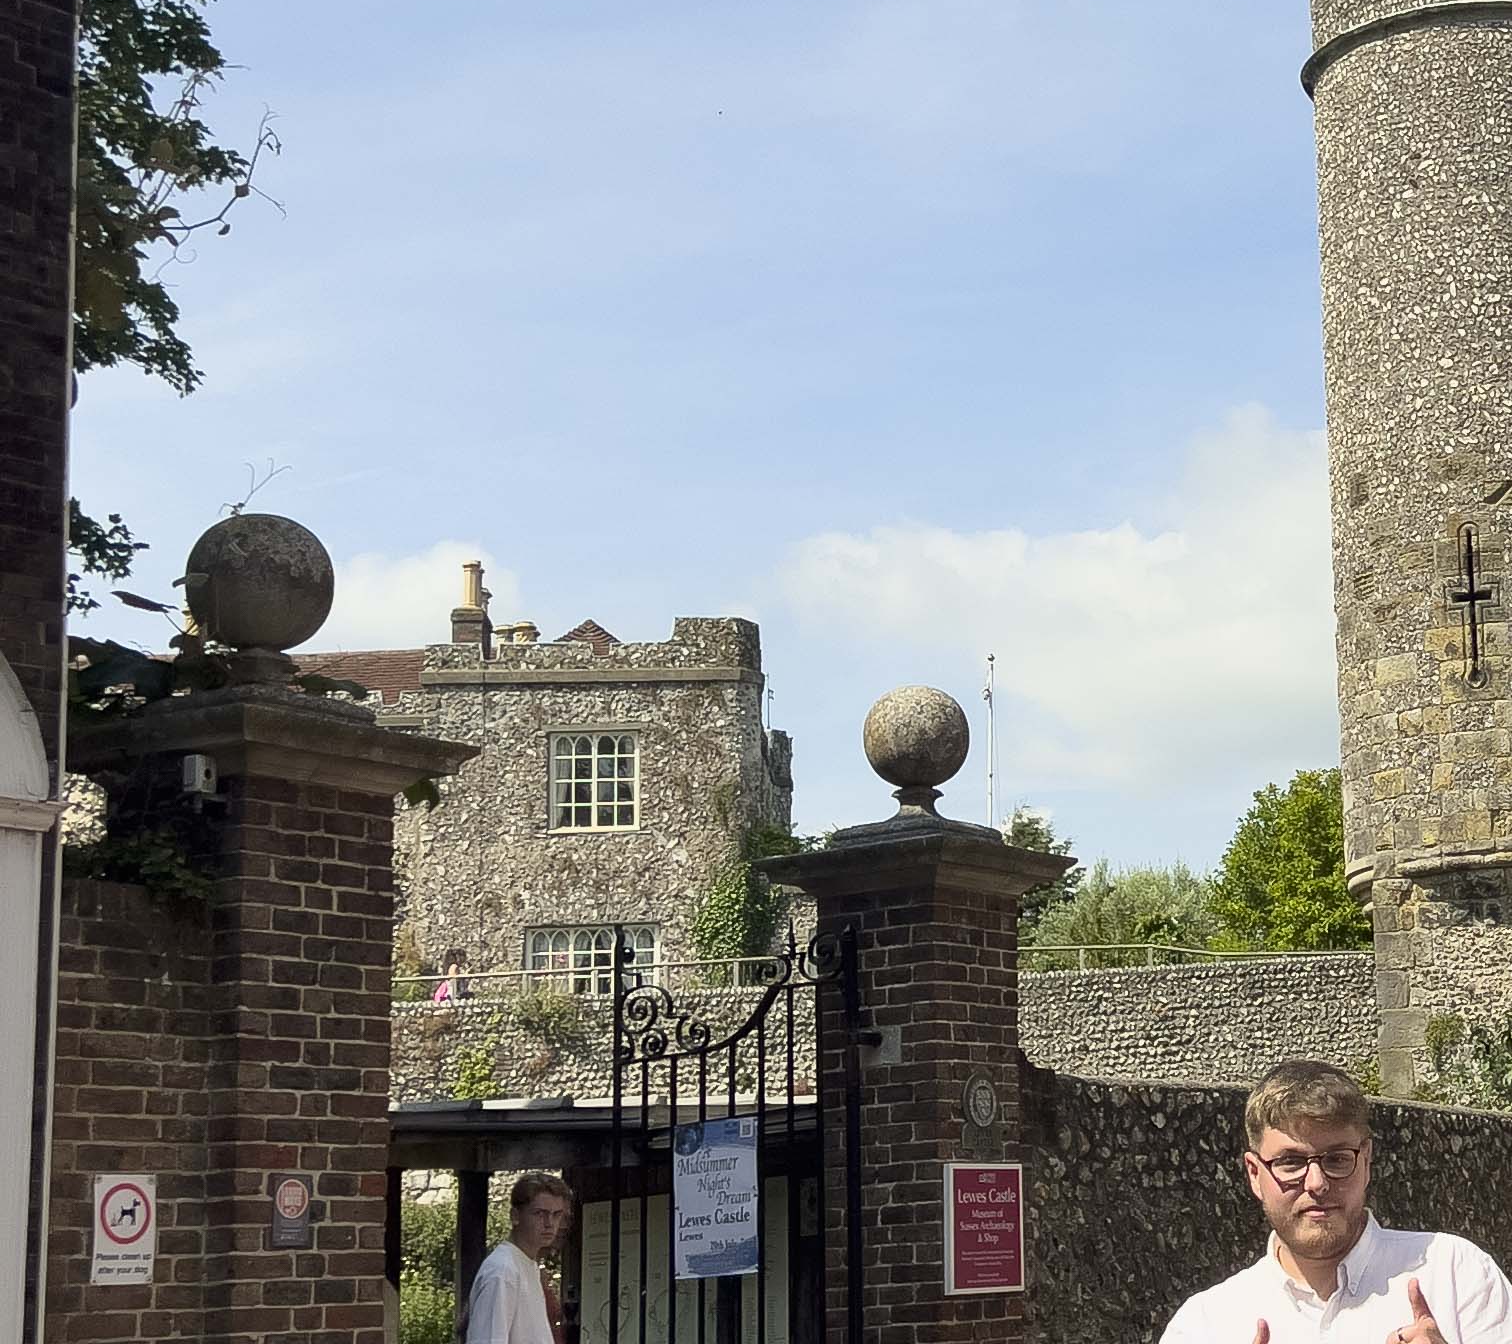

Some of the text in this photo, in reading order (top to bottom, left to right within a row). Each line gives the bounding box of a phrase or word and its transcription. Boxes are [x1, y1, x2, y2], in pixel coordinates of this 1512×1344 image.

[678, 1153, 739, 1177] Midsummer
[697, 1173, 731, 1200] Night's
[716, 1190, 751, 1207] Dream
[957, 1186, 1017, 1204] Lewes Castle
[679, 1206, 750, 1229] Lewes Castle
[971, 1207, 1004, 1219] Museum of
[959, 1220, 1015, 1233] Sussex Archaeology
[679, 1231, 704, 1242] Lewes
[977, 1232, 999, 1245] & Shop
[116, 1266, 133, 1277] your
[133, 1265, 149, 1277] dog
